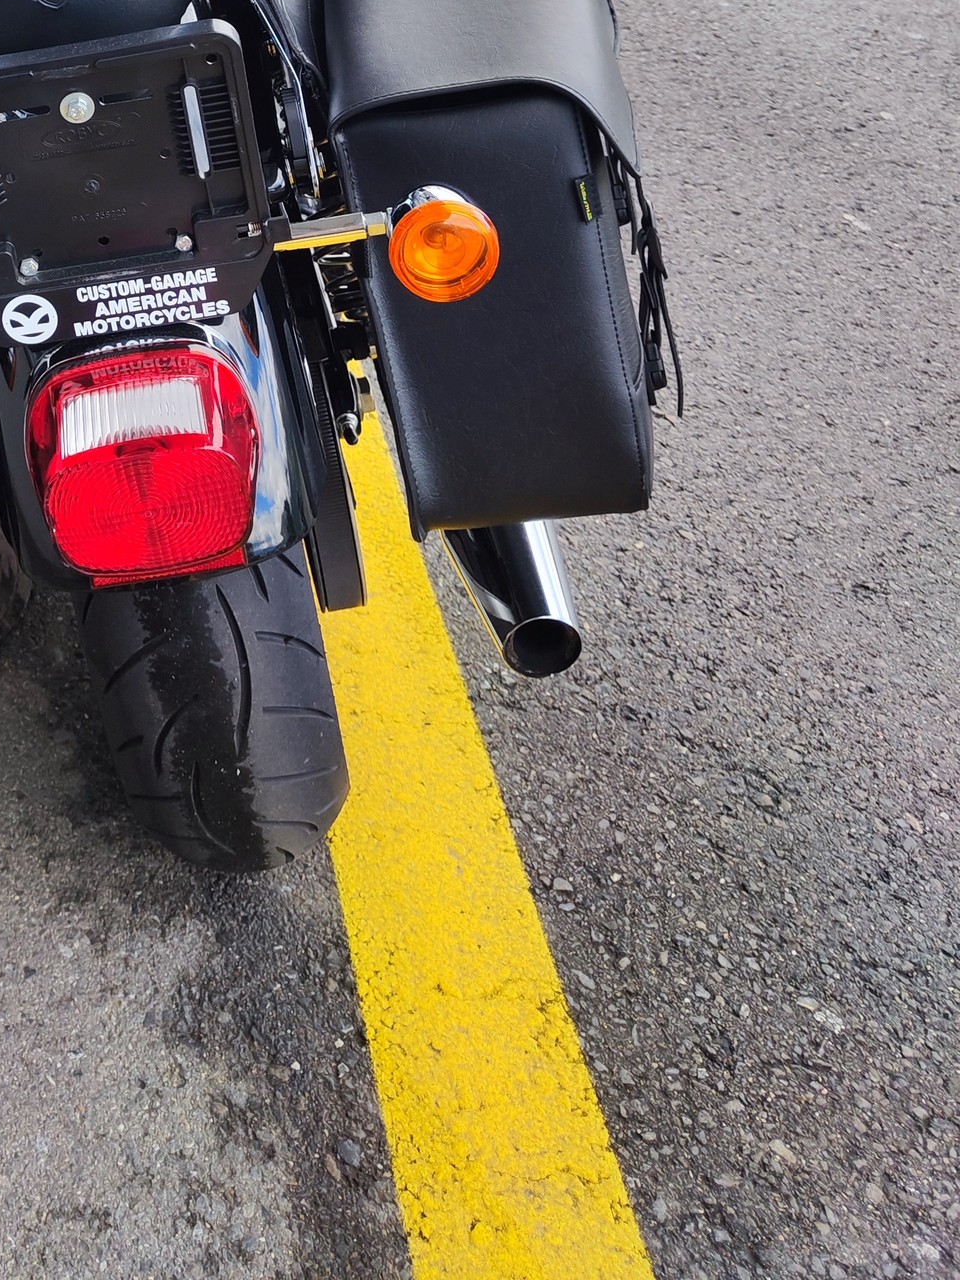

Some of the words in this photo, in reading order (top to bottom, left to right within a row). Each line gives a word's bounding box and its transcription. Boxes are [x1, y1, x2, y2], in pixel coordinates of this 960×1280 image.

[76, 267, 218, 303] CUSTOM-GARAGE
[95, 286, 207, 317] AMERICAN
[73, 300, 231, 337] MOTORCYCLES
